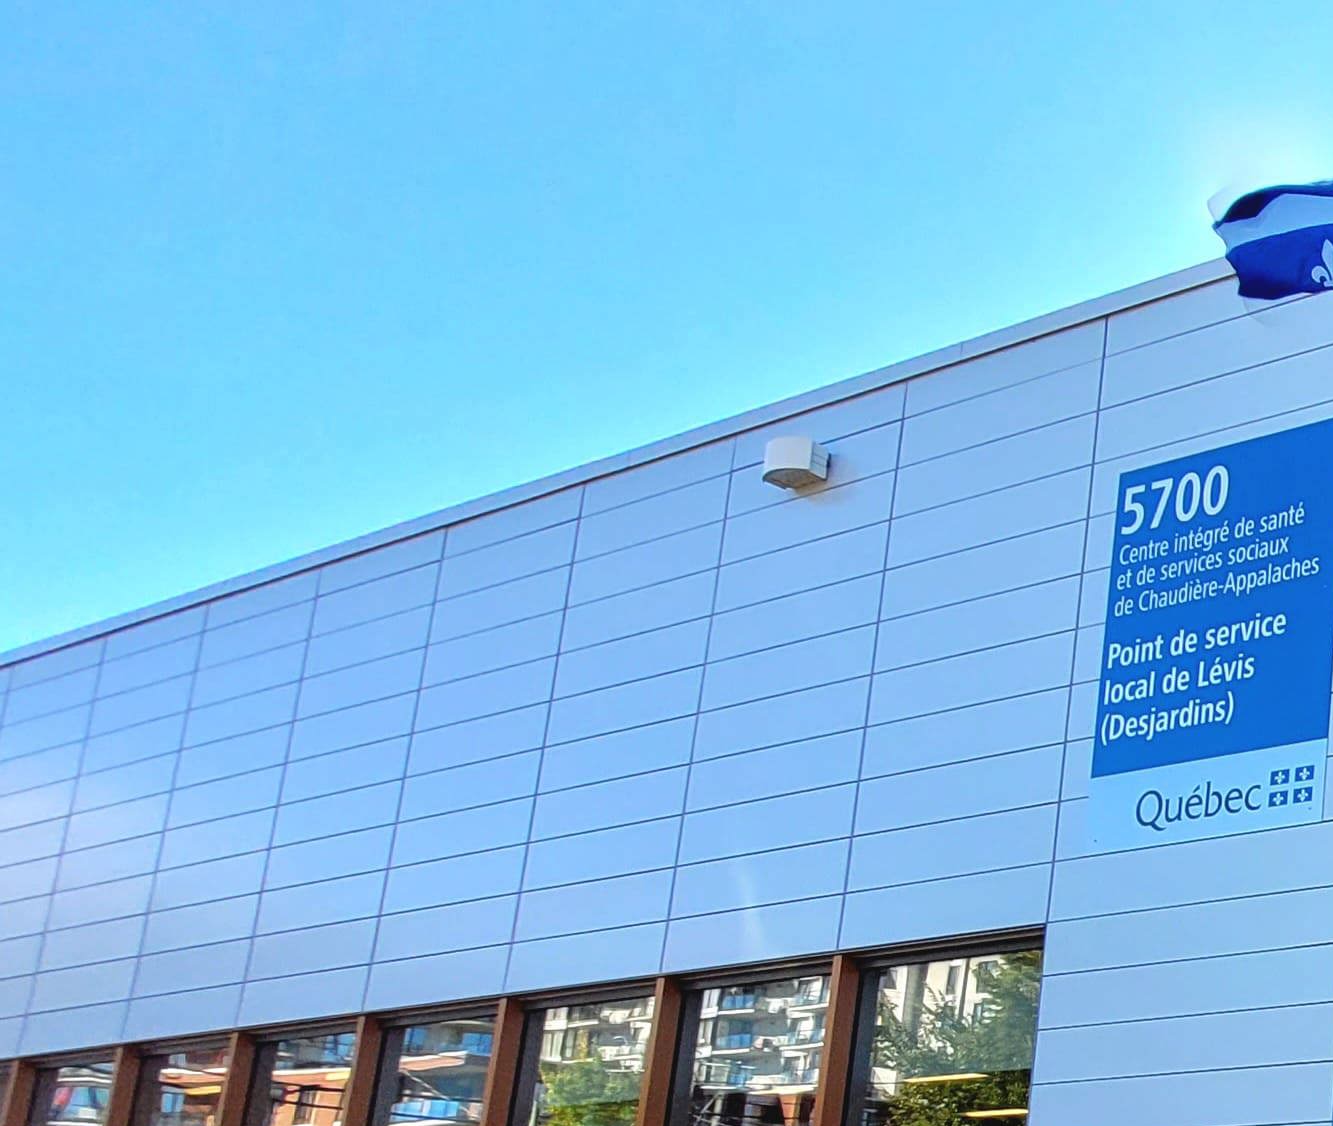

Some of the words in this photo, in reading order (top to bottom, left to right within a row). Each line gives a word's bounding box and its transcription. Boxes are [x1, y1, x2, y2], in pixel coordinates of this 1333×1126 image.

[1121, 465, 1229, 535] 5700
[1119, 539, 1169, 565] Centre
[1173, 520, 1230, 551] intégré
[1234, 516, 1255, 538] de
[1259, 501, 1305, 533] santé
[1114, 595, 1133, 617] de
[1138, 557, 1320, 611] Chaudière-Appalaches
[1116, 569, 1132, 590] et
[1136, 565, 1156, 587] de
[1160, 552, 1223, 580] services
[1227, 536, 1289, 565] sociaux
[1107, 634, 1164, 669] Point
[1169, 629, 1198, 656] de
[1204, 612, 1287, 649] service
[1104, 670, 1155, 705] local
[1162, 666, 1190, 694] de
[1197, 653, 1255, 687] Lévis
[1101, 690, 1234, 746] (Desjardins)
[1135, 781, 1261, 831] Québec
